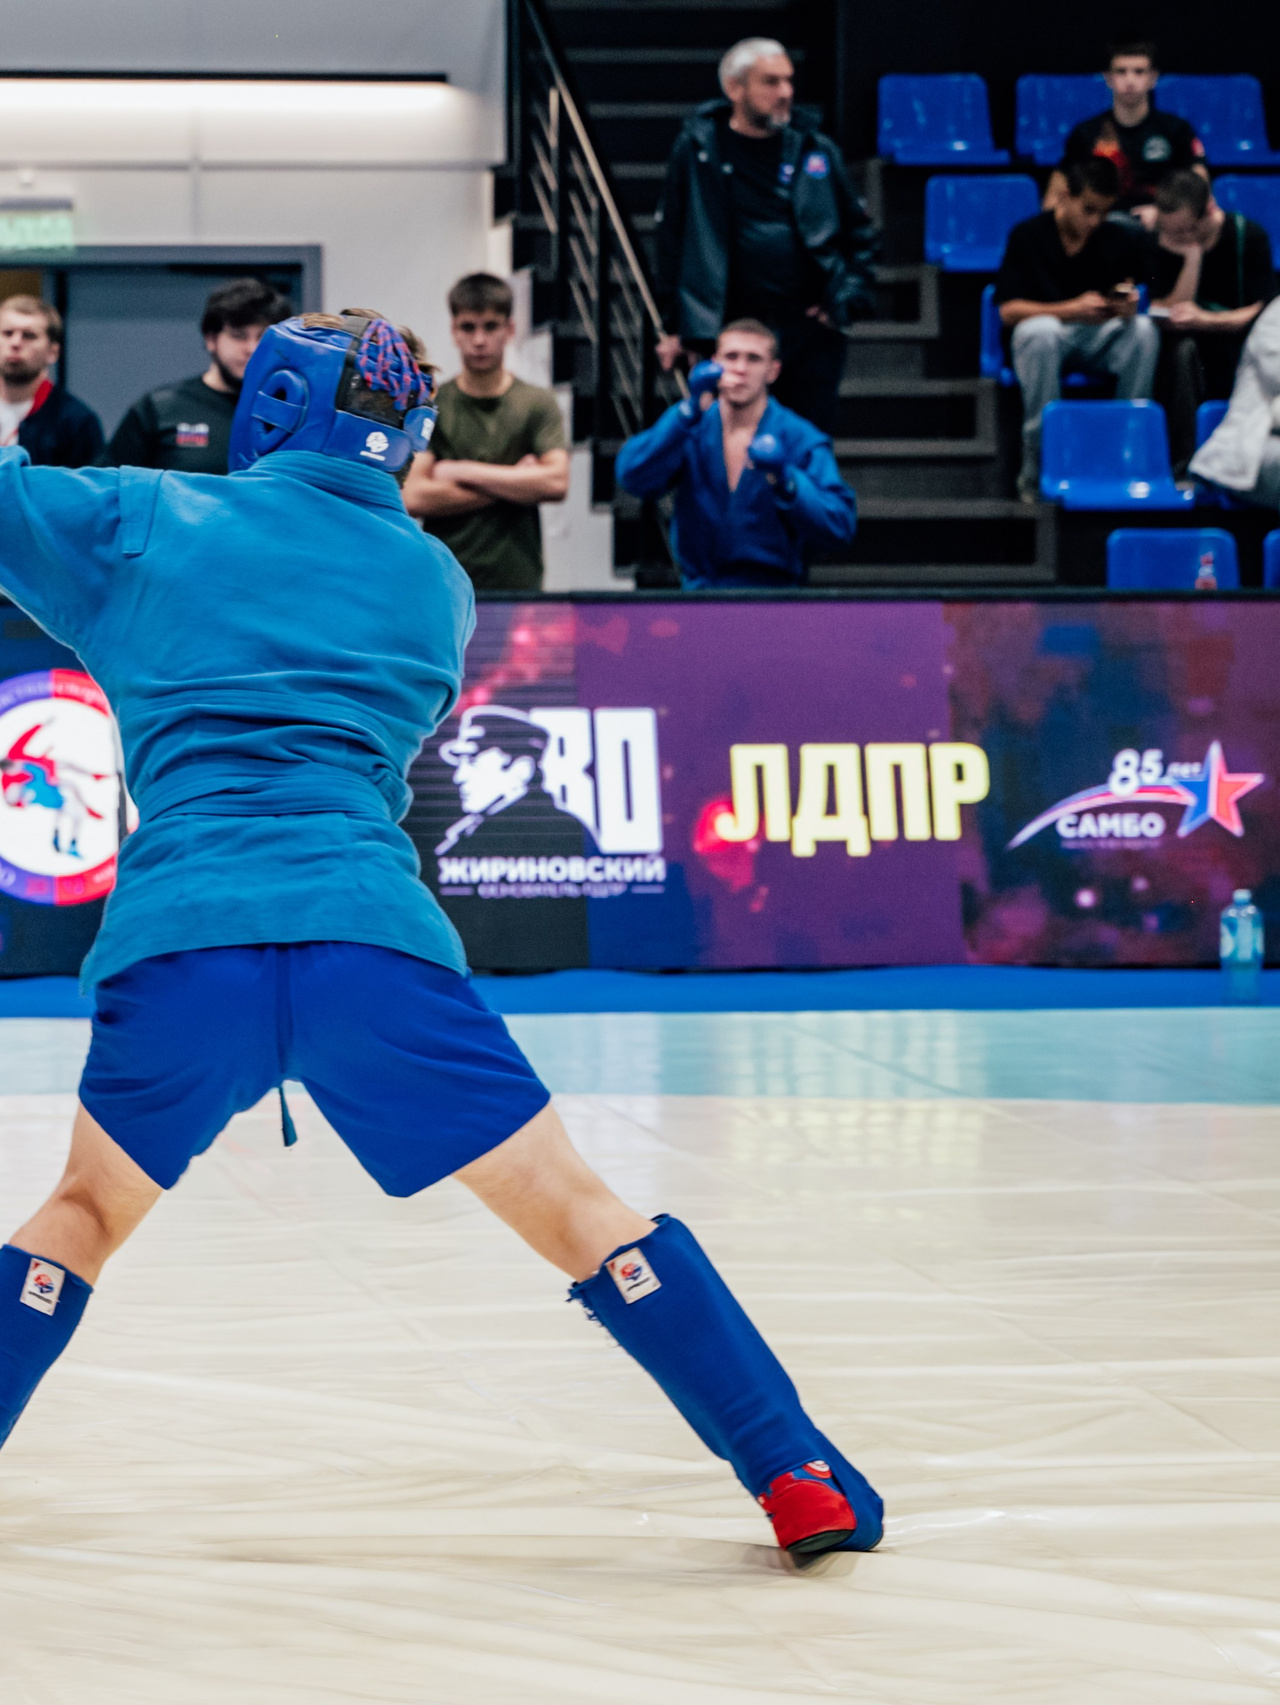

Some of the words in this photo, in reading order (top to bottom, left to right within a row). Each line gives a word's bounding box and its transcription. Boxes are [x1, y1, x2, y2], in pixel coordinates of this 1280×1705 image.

[1109, 748, 1163, 796] 85
[714, 742, 990, 857] ЛДПР
[1056, 812, 1166, 838] САМБО
[437, 853, 666, 883] ЖИРИНОВСКИЙ
